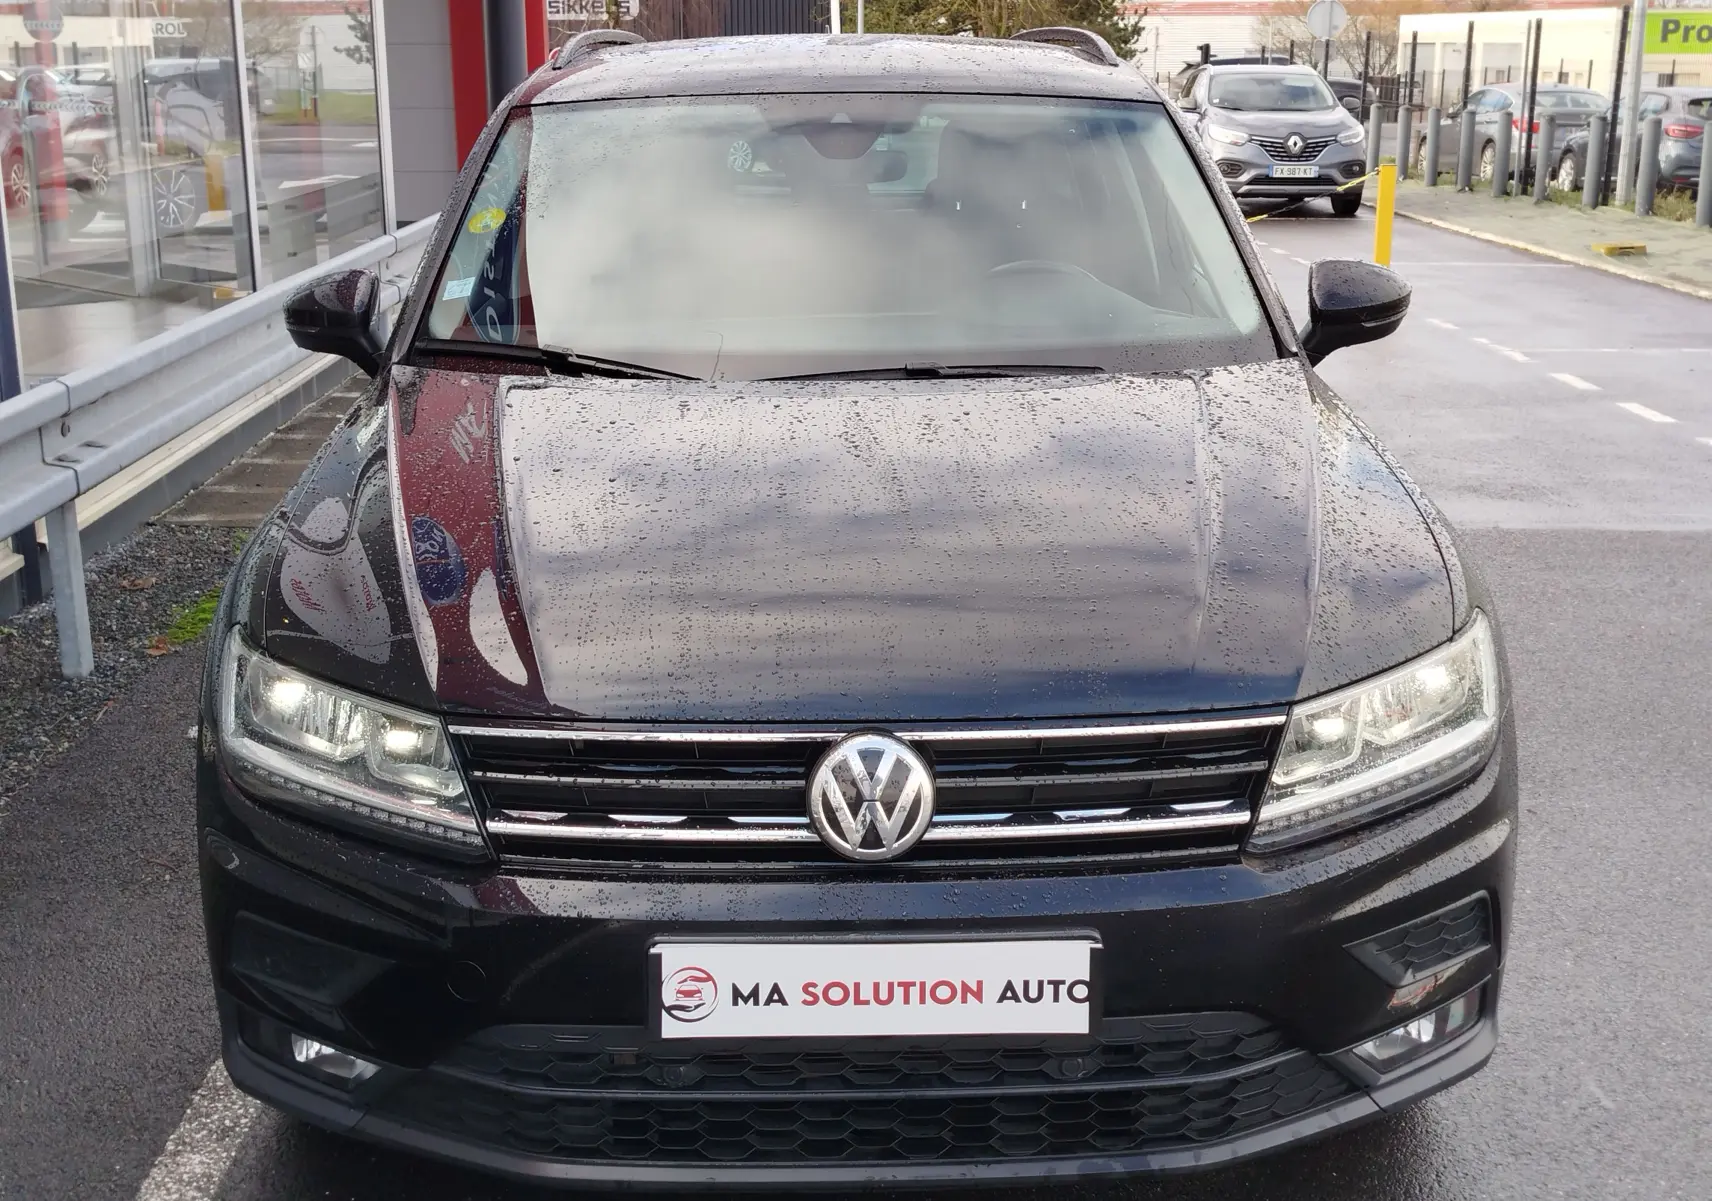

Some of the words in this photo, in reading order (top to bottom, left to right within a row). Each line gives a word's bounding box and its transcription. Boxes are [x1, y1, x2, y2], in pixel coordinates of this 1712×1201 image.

[548, 0, 630, 15] sikkes
[1660, 18, 1712, 43] Pro
[731, 982, 789, 1007] MA
[801, 979, 984, 1006] SOLUTION
[996, 979, 1090, 1004] AUTO
